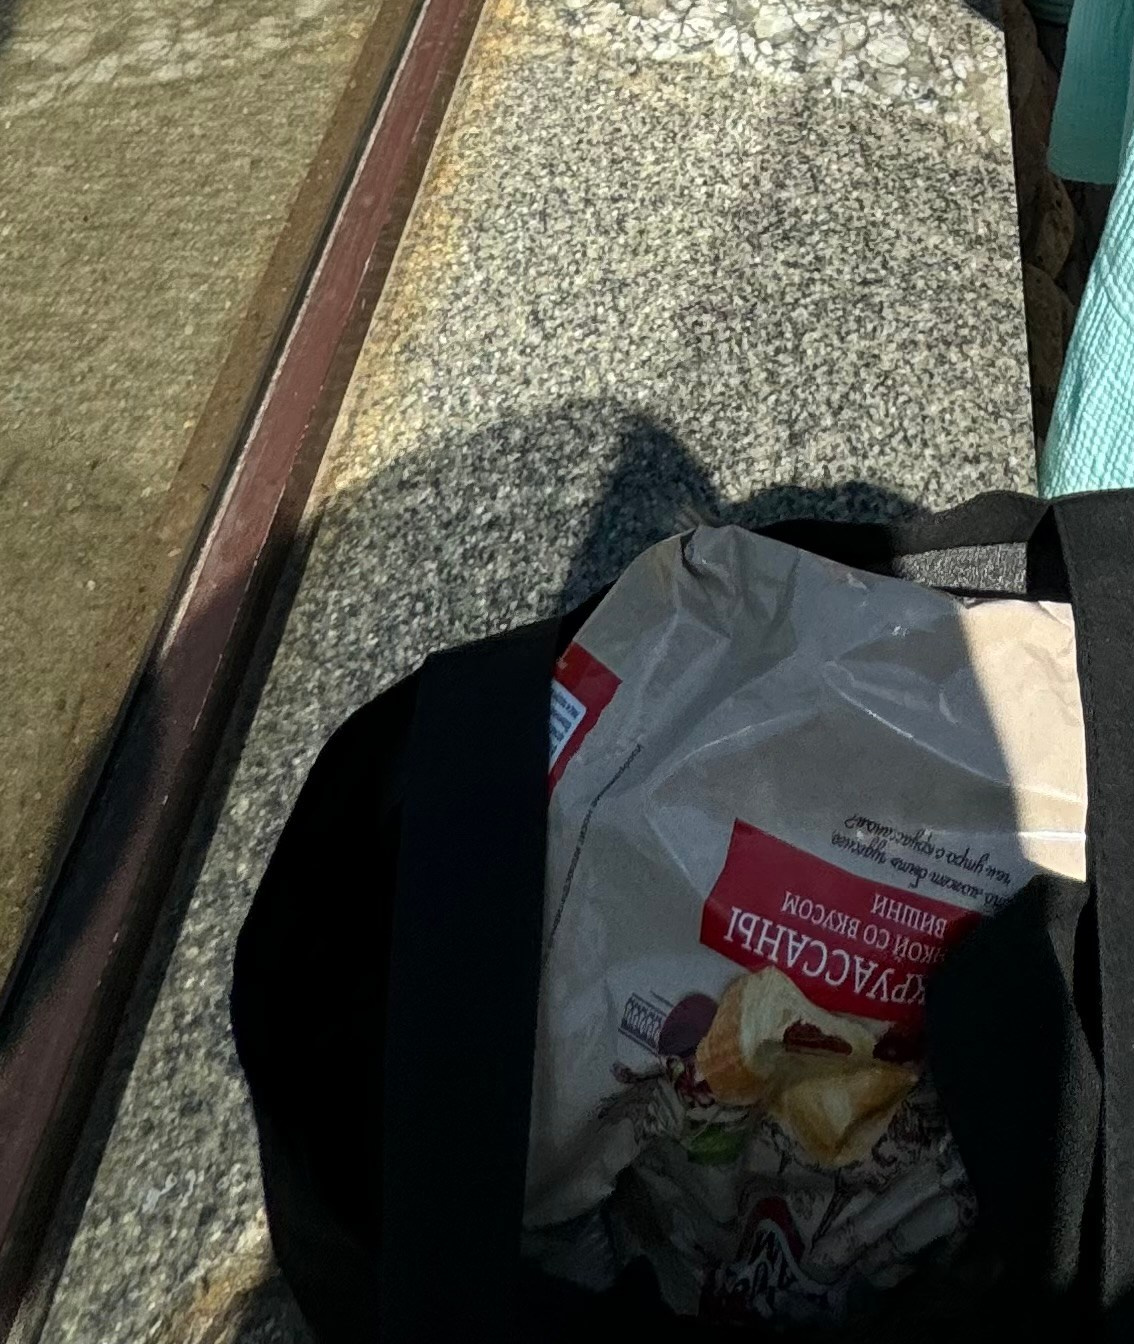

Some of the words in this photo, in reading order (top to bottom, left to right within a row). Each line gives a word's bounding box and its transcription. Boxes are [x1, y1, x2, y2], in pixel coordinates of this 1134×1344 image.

[946, 845, 991, 875] утро
[781, 890, 860, 940] ВКУСОМ
[862, 924, 891, 951] СО
[870, 893, 948, 938] ВИШНИ
[723, 905, 928, 1006] КРУАССАНЫ
